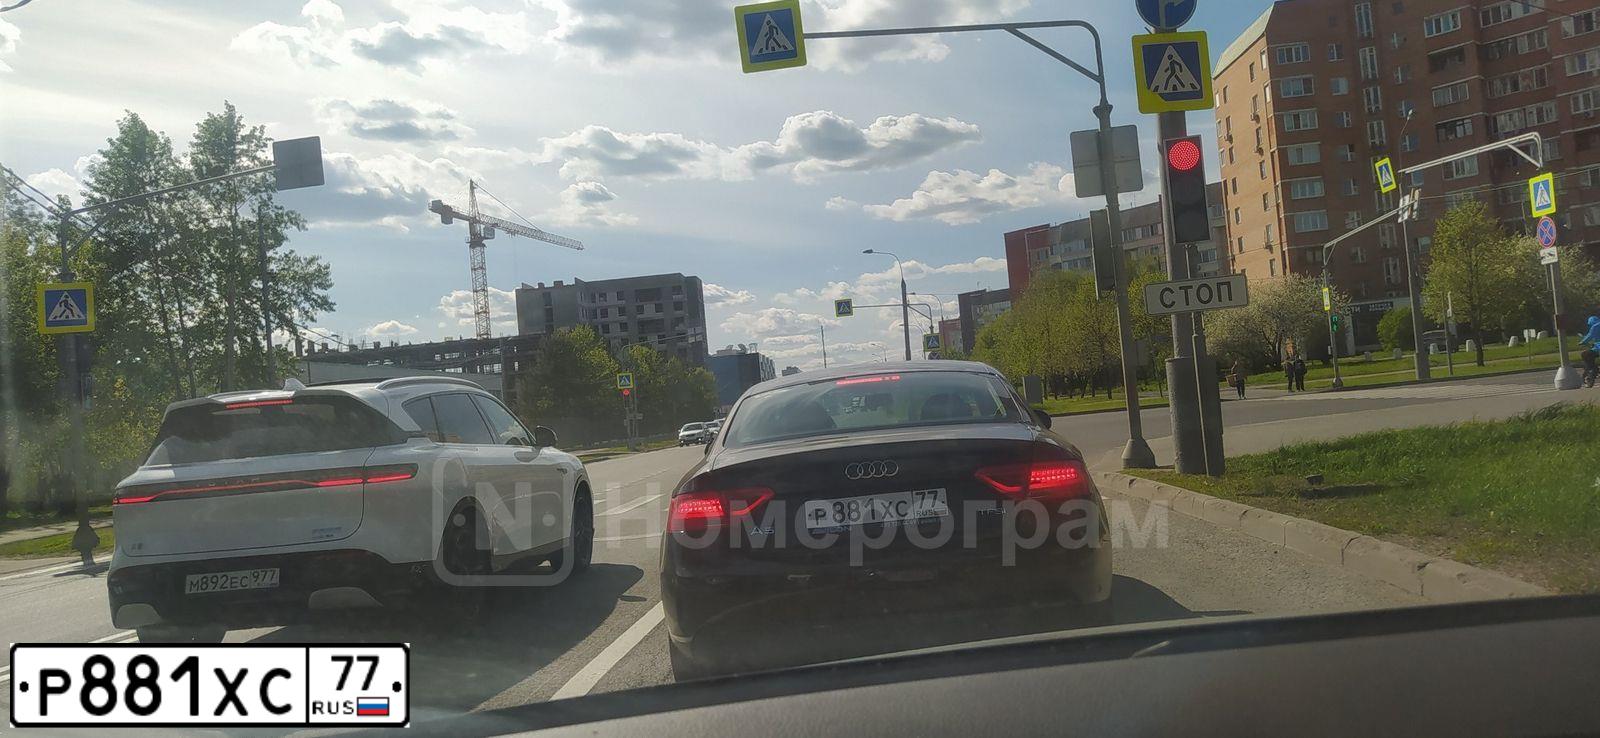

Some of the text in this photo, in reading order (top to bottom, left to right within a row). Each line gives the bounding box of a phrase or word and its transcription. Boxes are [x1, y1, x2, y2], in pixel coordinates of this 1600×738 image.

[1160, 281, 1232, 308] СТОП
[915, 490, 938, 509] 77
[252, 570, 276, 582] 977
